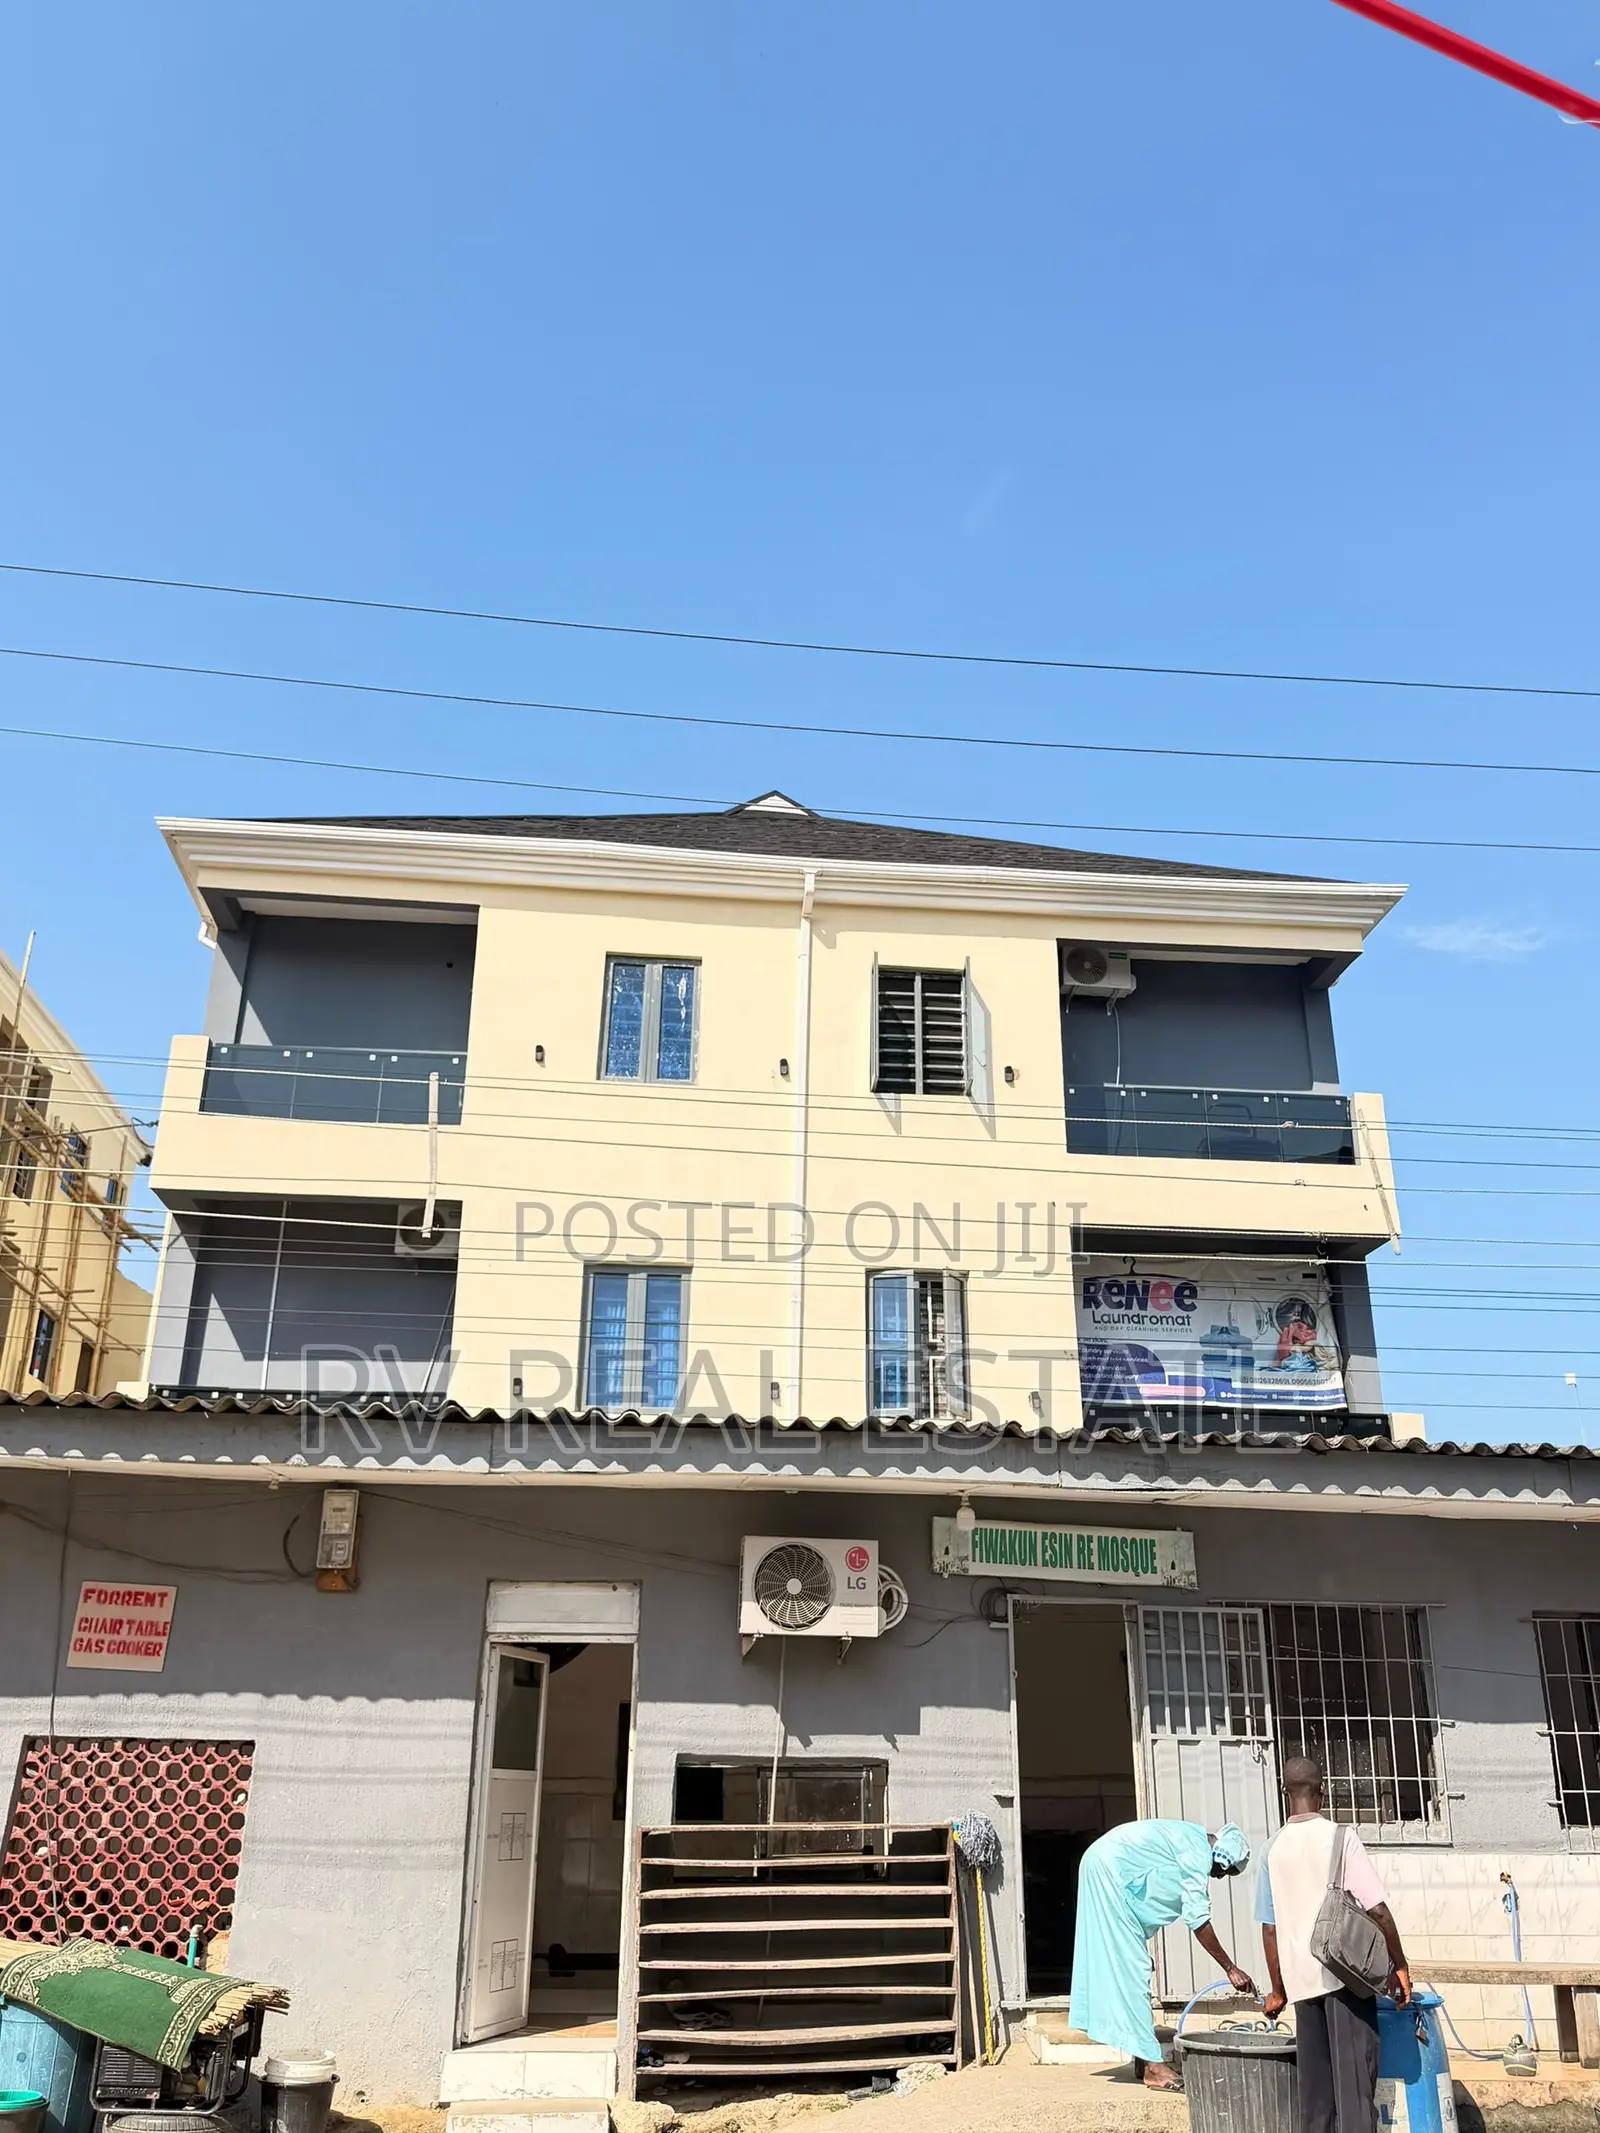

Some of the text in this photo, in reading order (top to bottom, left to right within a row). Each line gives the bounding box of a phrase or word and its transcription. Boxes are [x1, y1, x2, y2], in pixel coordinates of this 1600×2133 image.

[1092, 1310, 1192, 1326] Laundromat
[971, 1527, 1158, 1578] FIWAKUN ESIN RE MOSQUE
[847, 1577, 867, 1590] LG
[77, 1616, 170, 1637] CHAIR TABLE
[73, 1637, 164, 1657] GAS COOKER
